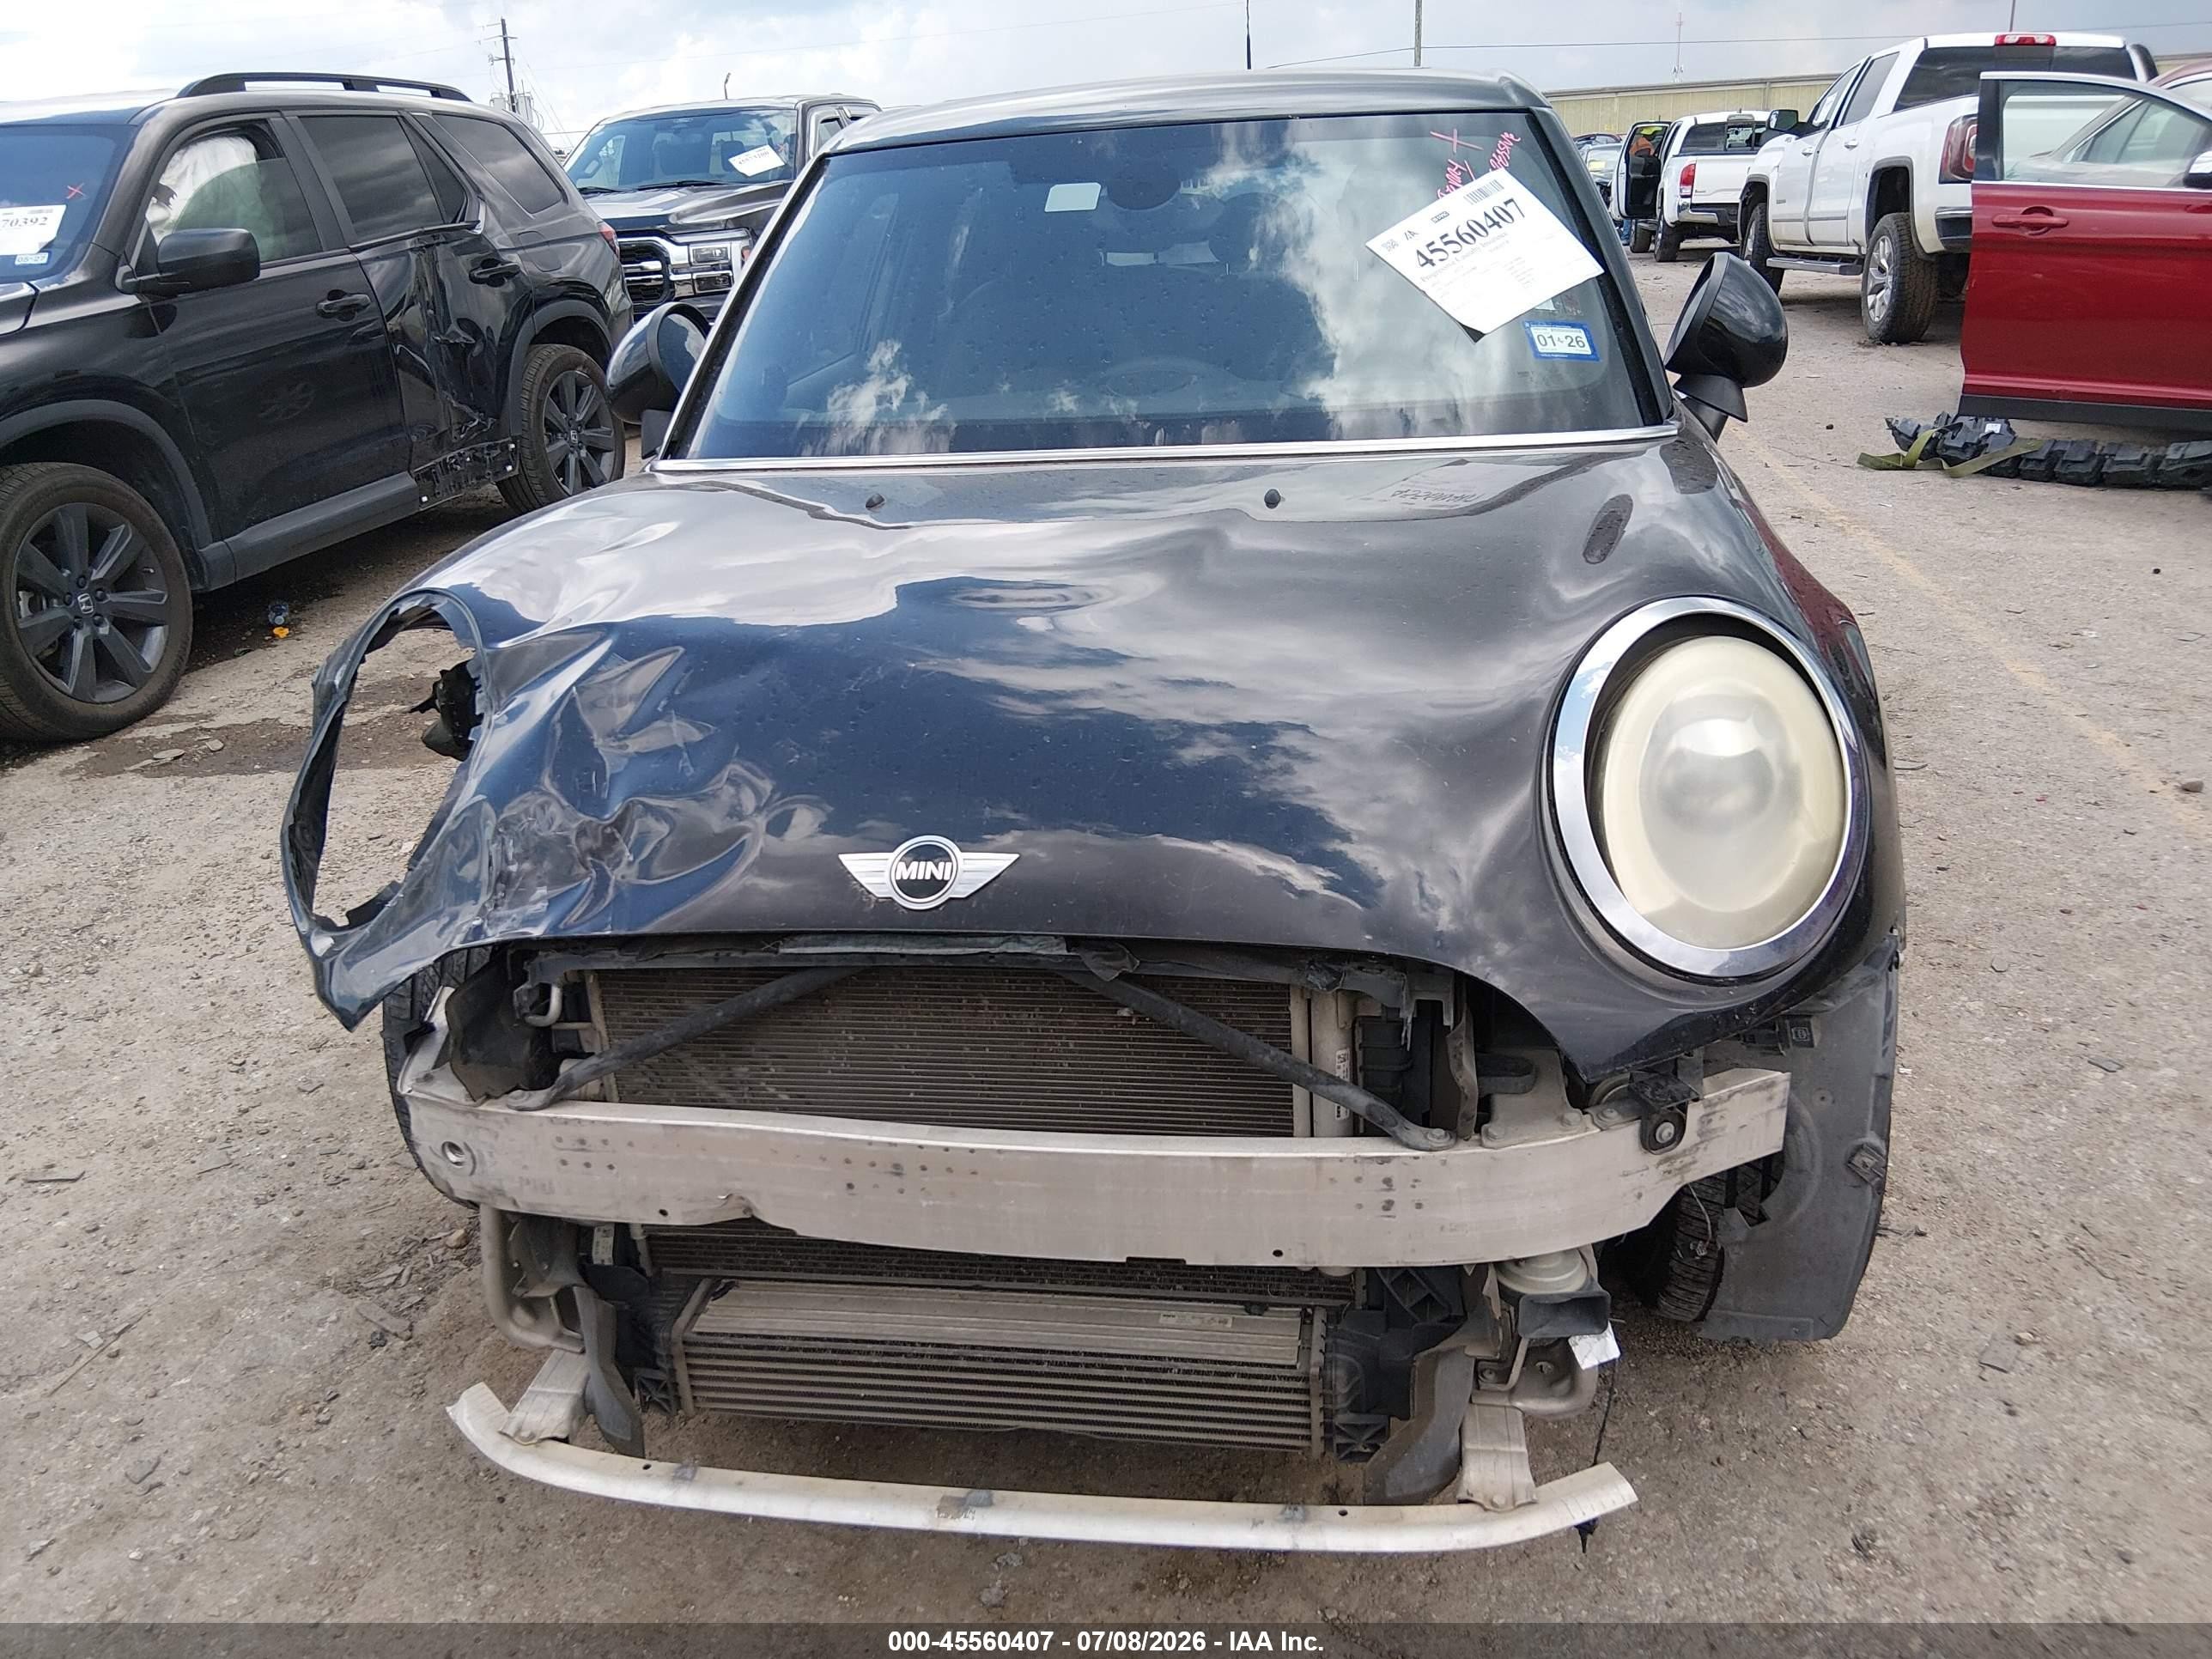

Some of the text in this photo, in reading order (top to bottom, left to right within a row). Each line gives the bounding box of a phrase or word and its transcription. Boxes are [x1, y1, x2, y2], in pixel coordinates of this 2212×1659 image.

[1416, 198, 1525, 269] 45560407
[1536, 334, 1586, 349] 01 26
[895, 860, 953, 881] MINI
